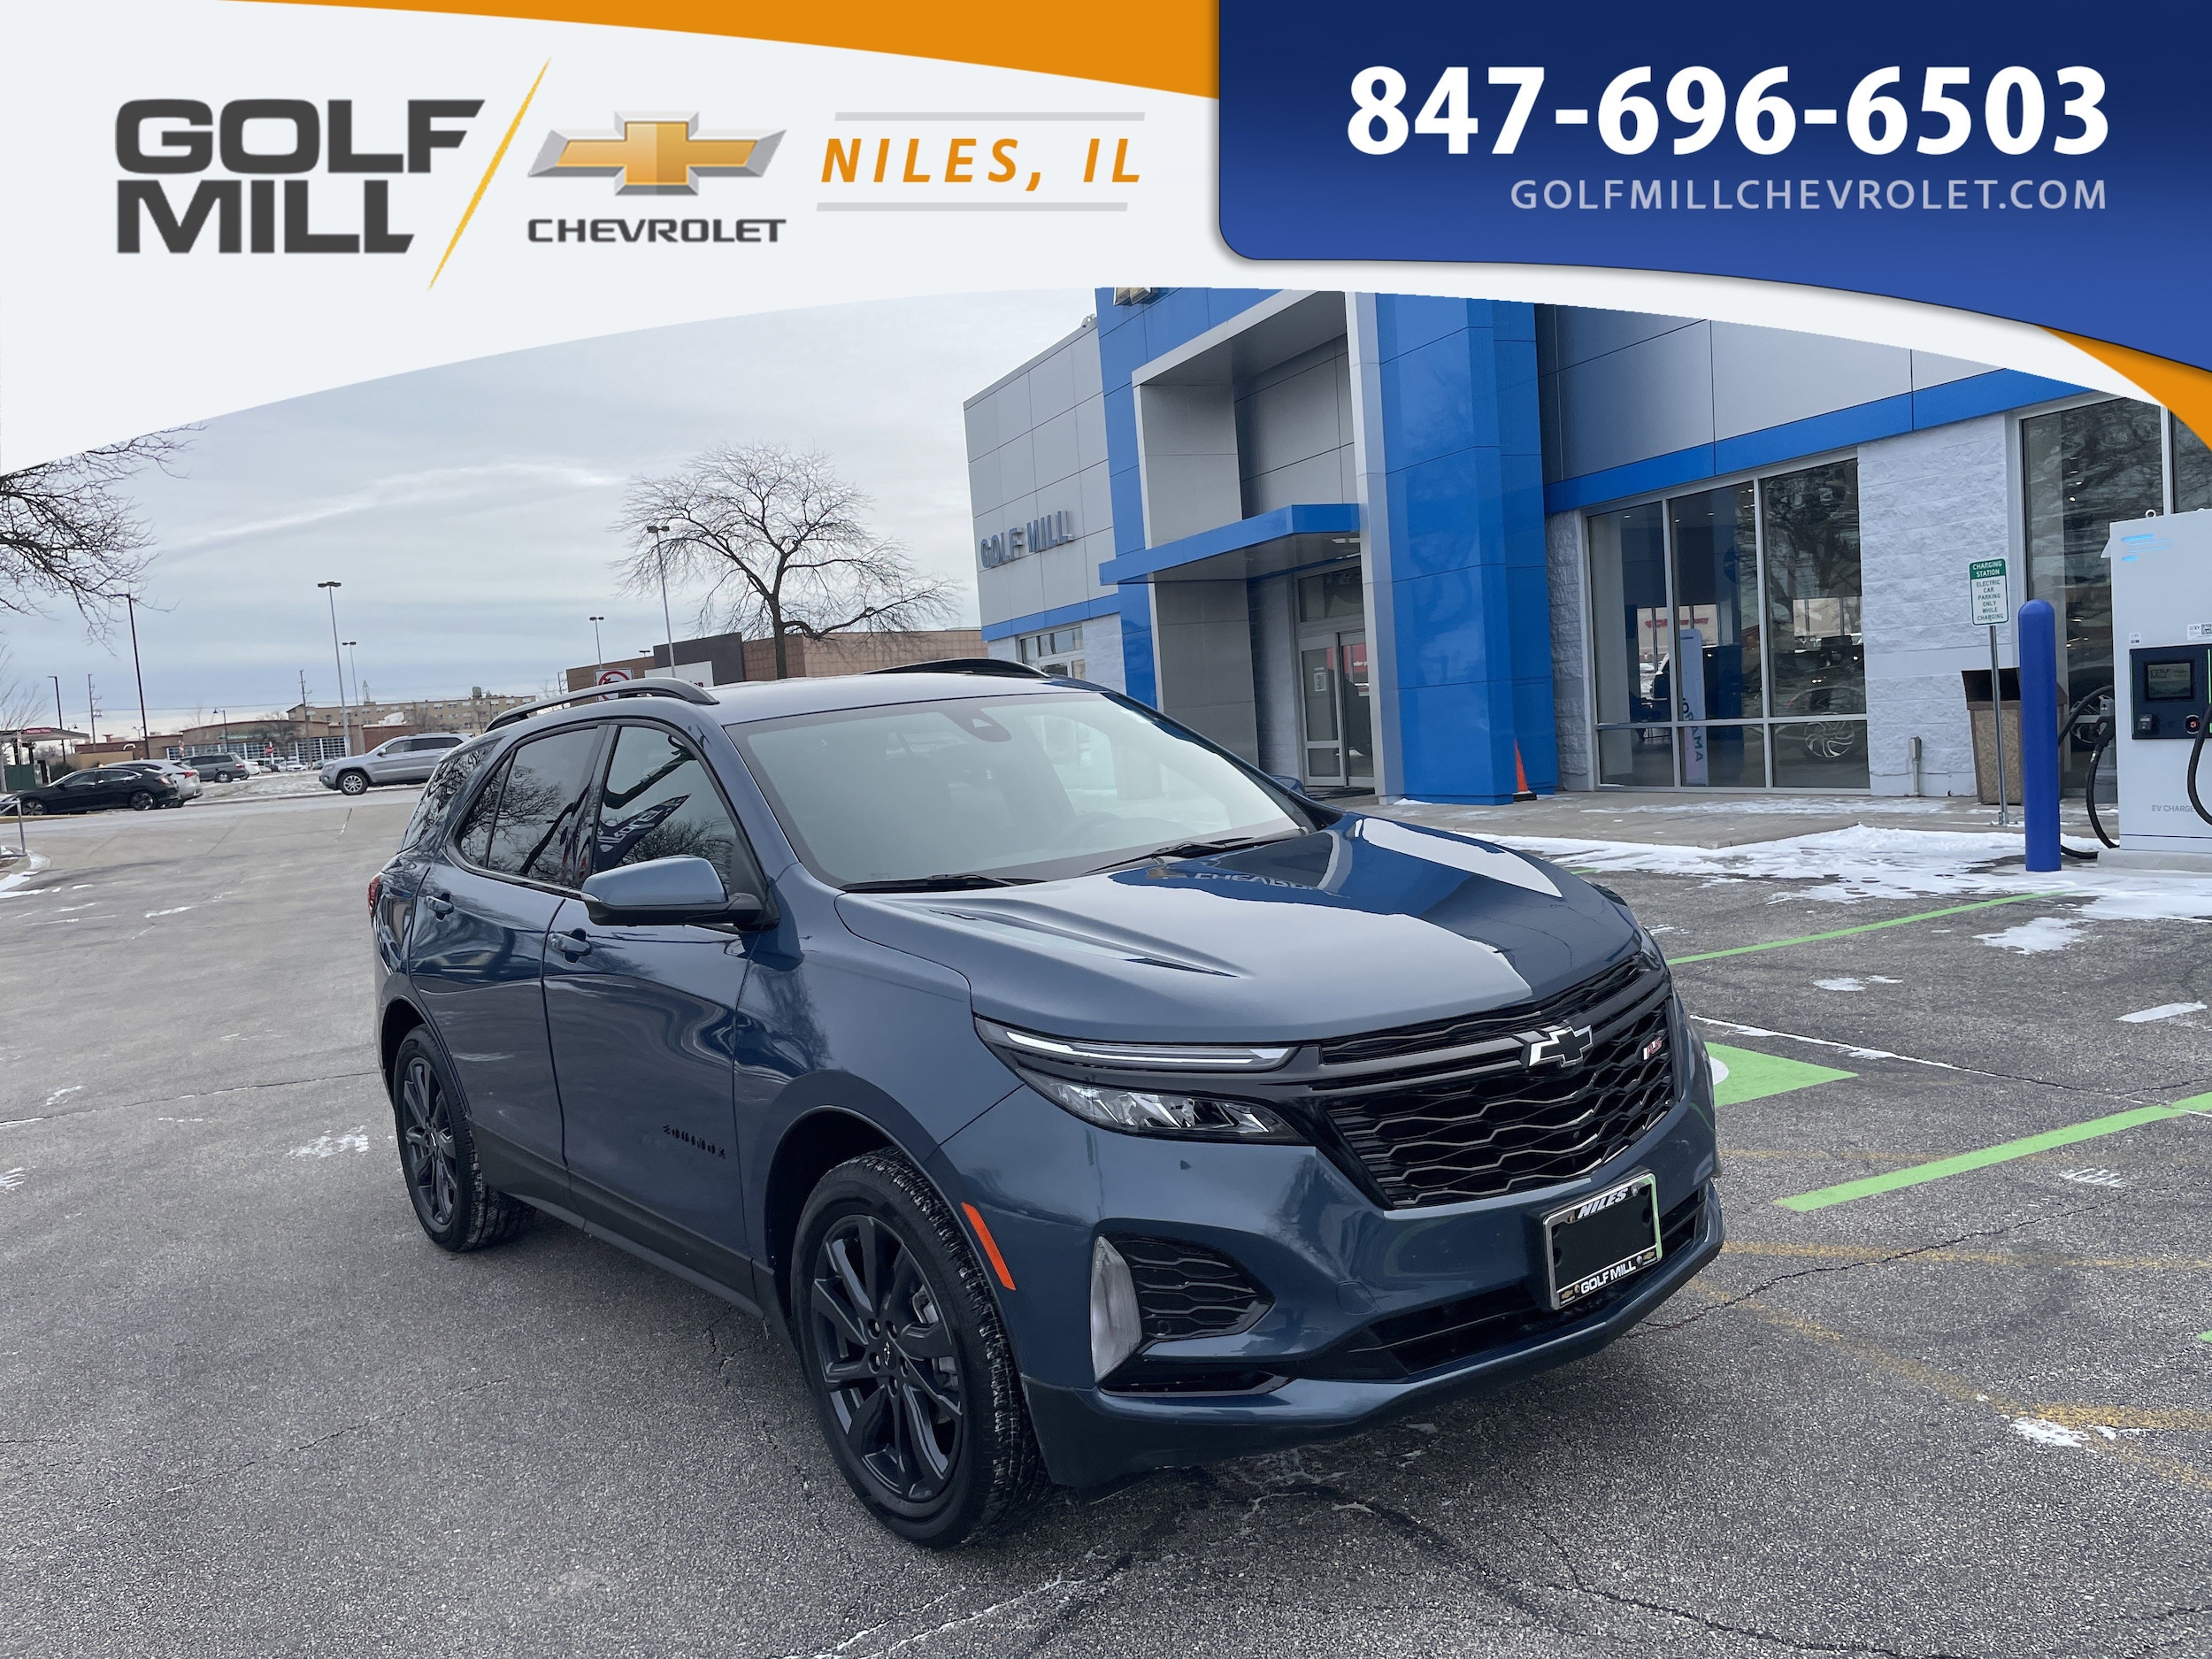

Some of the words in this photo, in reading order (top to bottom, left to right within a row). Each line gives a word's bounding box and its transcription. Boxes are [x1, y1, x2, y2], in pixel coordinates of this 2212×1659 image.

[980, 527, 1021, 568] GOLF
[1026, 511, 1071, 553] MILL
[1972, 560, 2002, 570] CHARGING
[1976, 569, 2000, 578] STATION
[1578, 1188, 1628, 1219] NILES
[1581, 1271, 1609, 1294] GOLF
[1610, 1260, 1636, 1281] MILL
